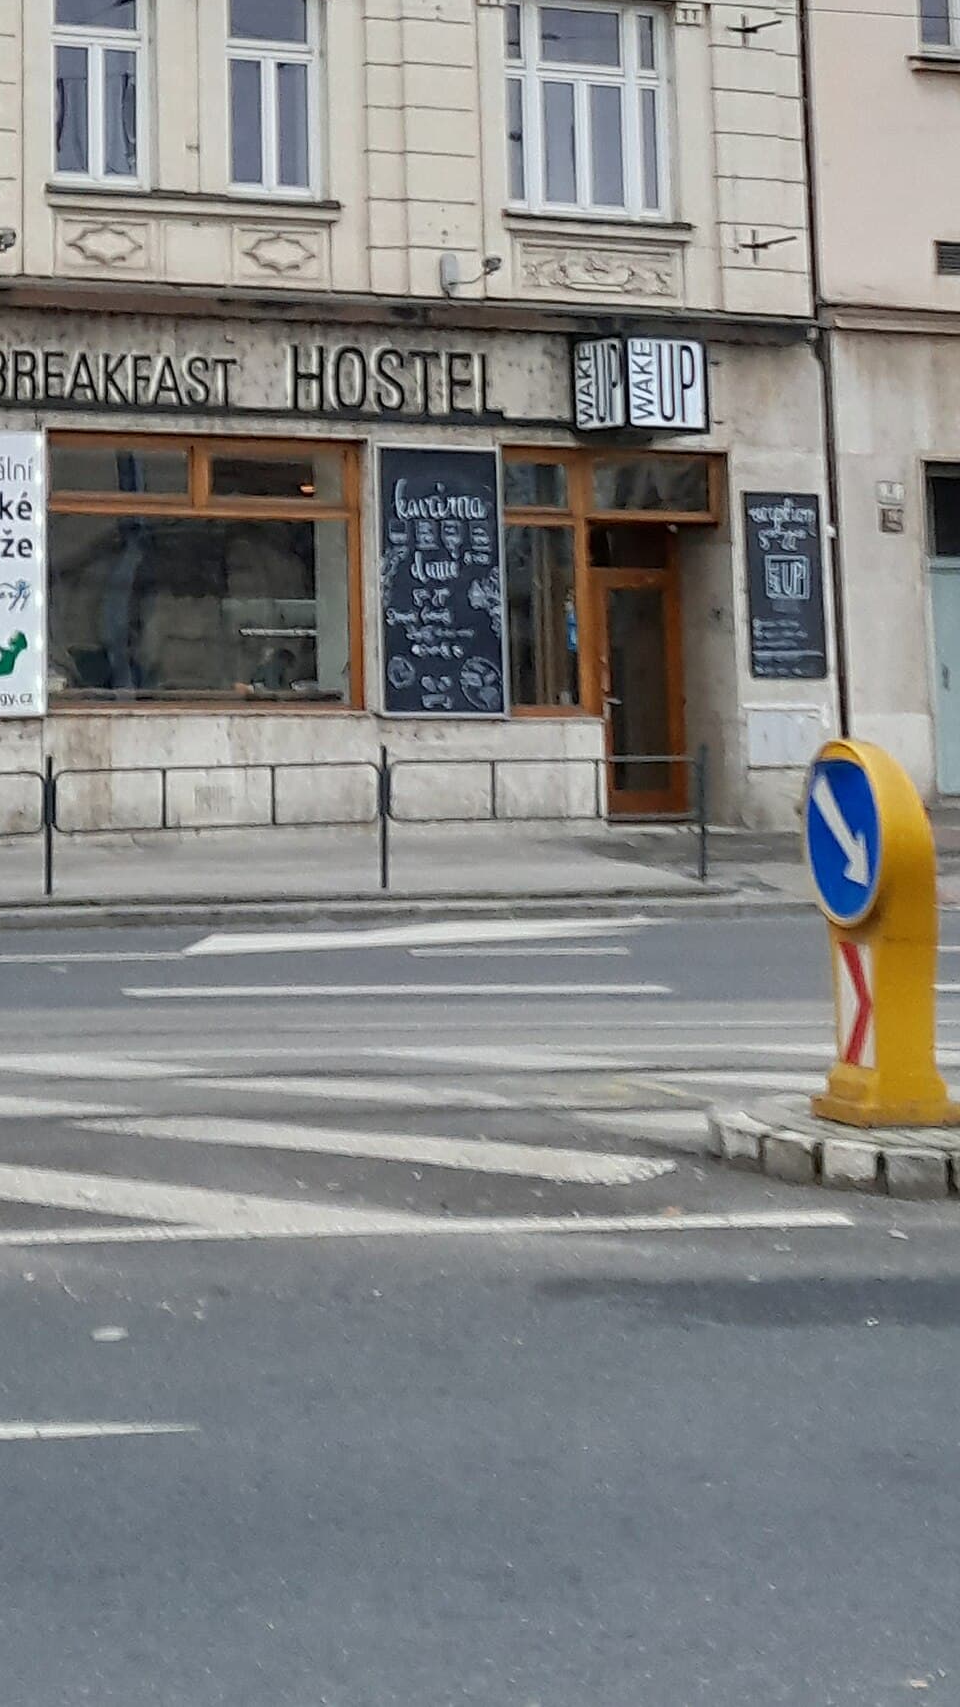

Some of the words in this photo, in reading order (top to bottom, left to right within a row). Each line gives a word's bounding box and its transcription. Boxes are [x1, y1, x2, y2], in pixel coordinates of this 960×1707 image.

[288, 344, 503, 414] HOSTEL
[577, 343, 595, 425] WAKE
[594, 343, 620, 423] UP
[631, 341, 656, 420] WAKE
[657, 343, 696, 423] UP
